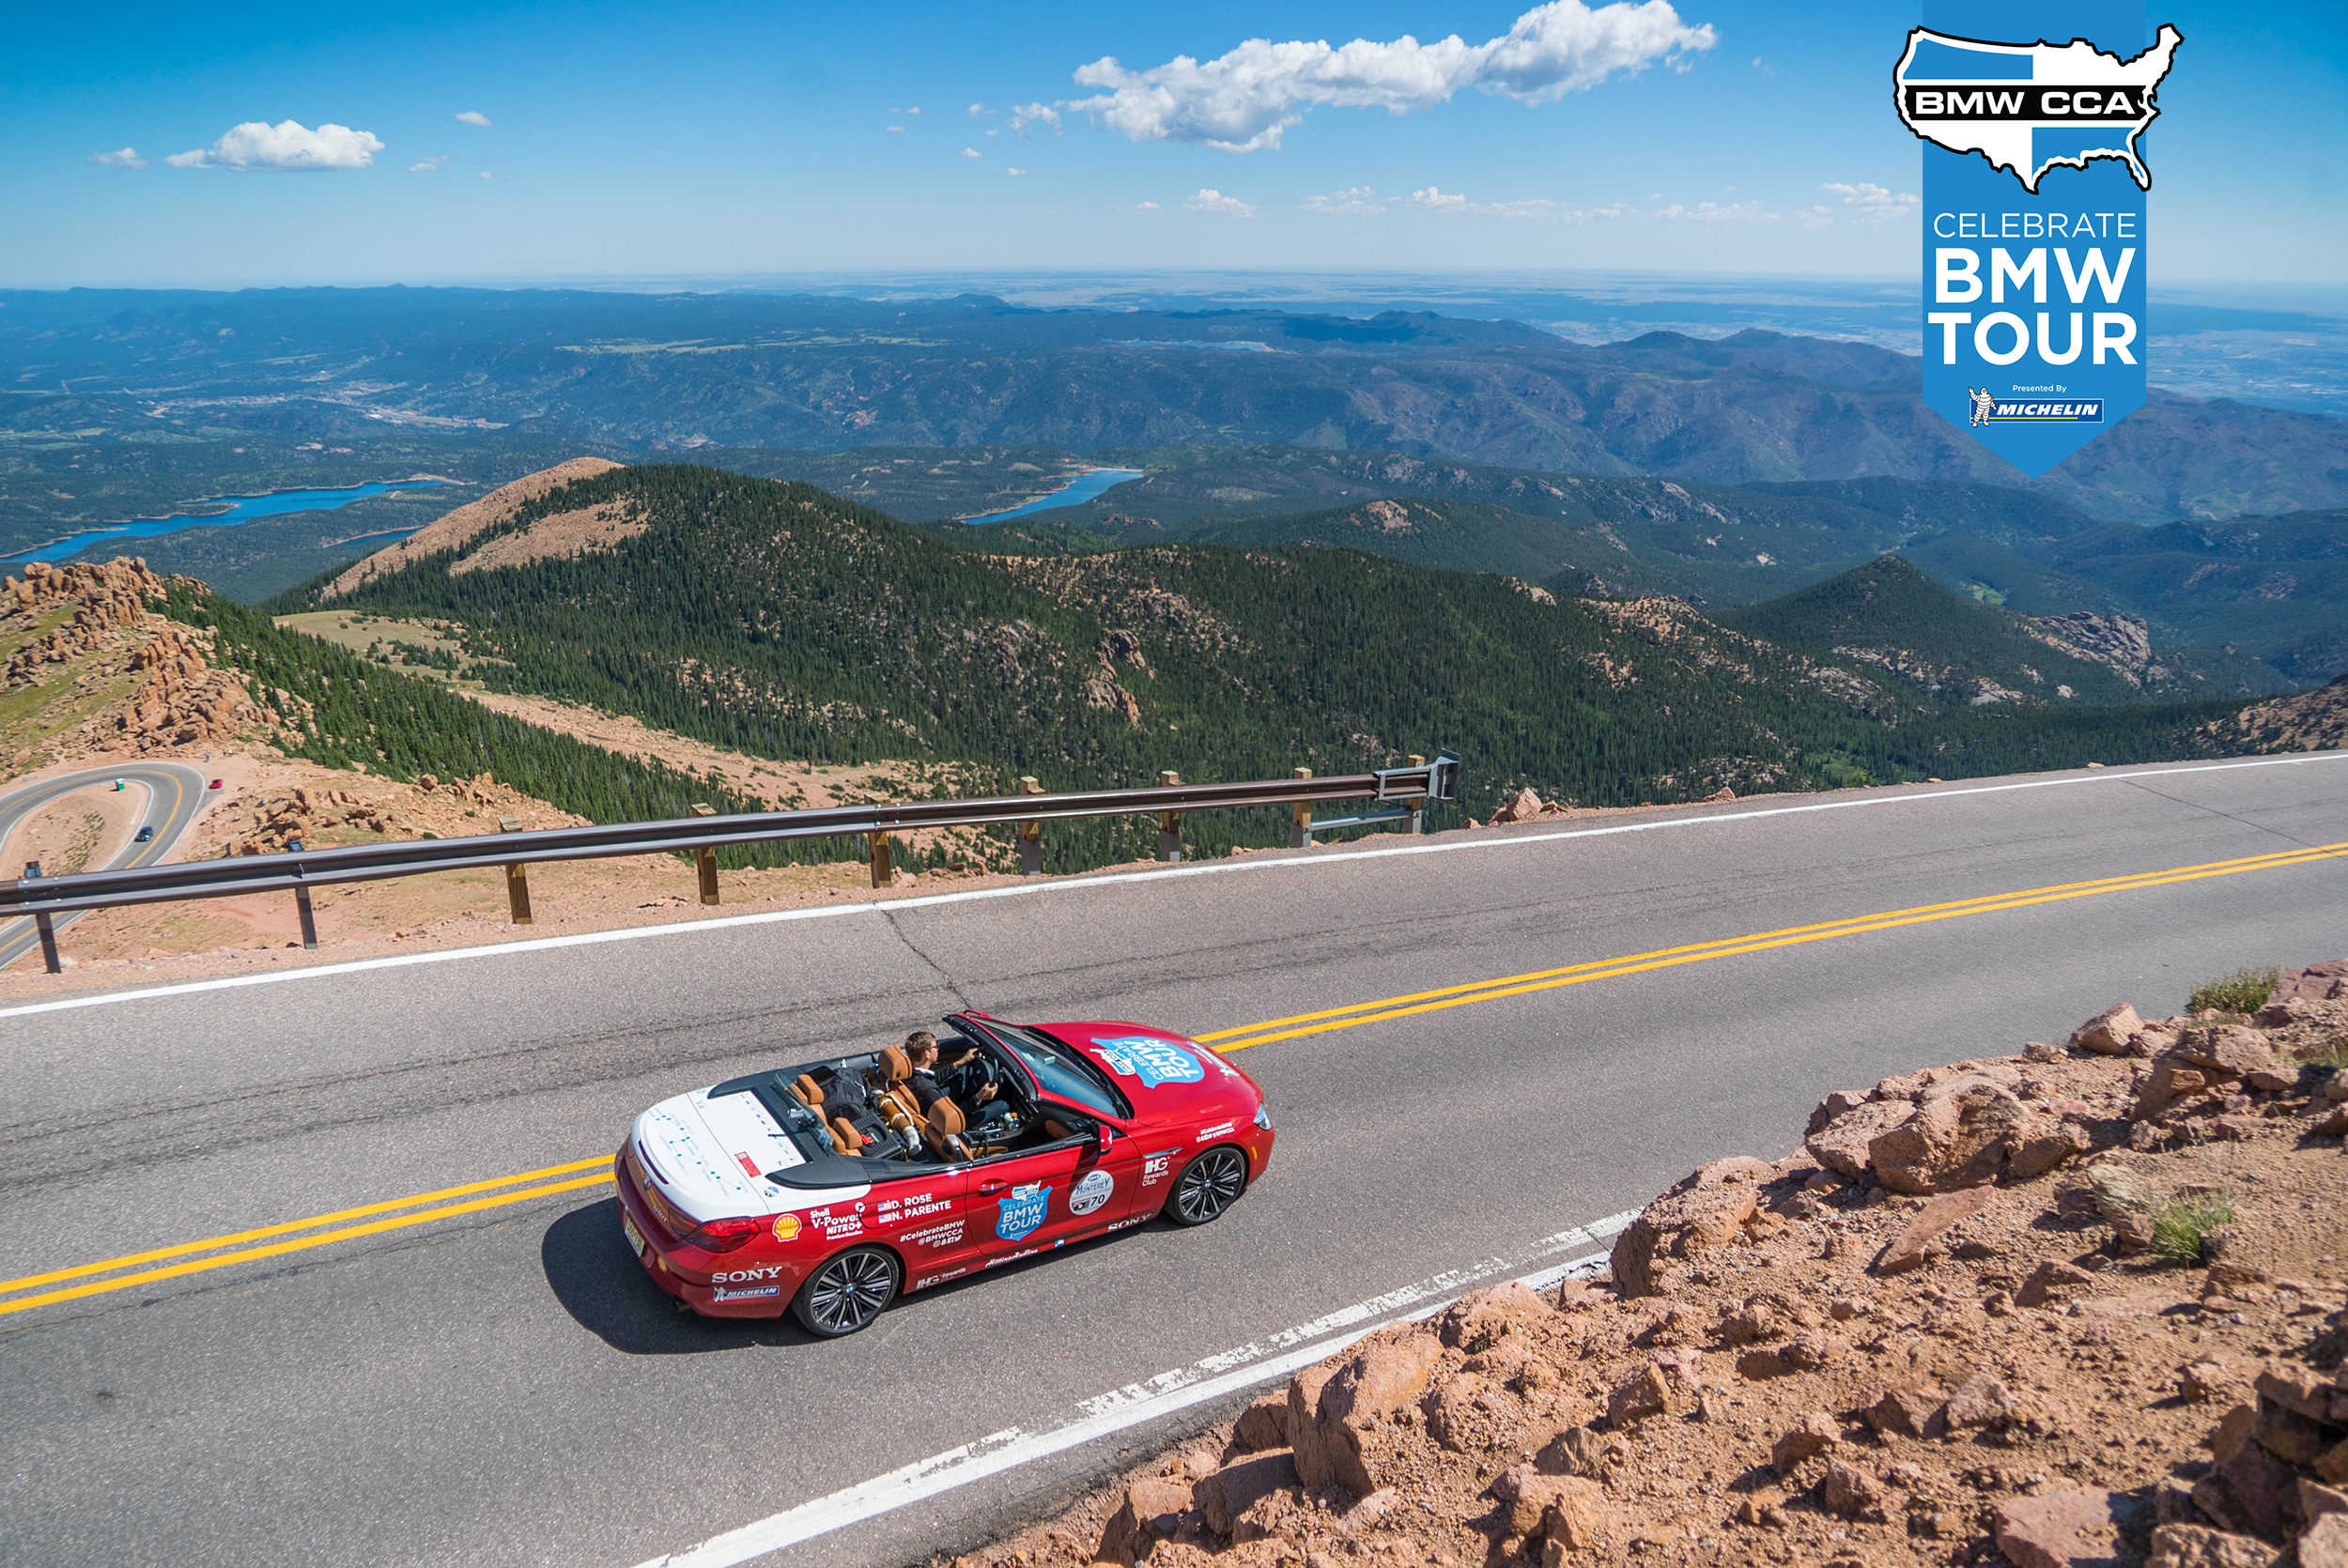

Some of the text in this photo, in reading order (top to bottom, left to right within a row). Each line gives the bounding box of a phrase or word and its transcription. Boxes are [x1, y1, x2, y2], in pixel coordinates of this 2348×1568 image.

[1112, 1041, 1165, 1081] CELEBRATE
[1124, 1040, 1183, 1079] BMW
[1143, 1038, 1200, 1079] TOUR
[1142, 1178, 1157, 1187] Club
[891, 1192, 933, 1210] D. ROSE
[1003, 1195, 1045, 1211] CELEBRATE
[1090, 1194, 1105, 1207] 70
[810, 1207, 830, 1220] Shell
[892, 1200, 951, 1222] N. PARENTE
[1003, 1202, 1044, 1223] BMW
[811, 1214, 863, 1229] V-Power
[1000, 1214, 1042, 1234] TOUR
[1107, 1213, 1152, 1232] SONY
[900, 1220, 965, 1243] #CelebrateBMW
[918, 1228, 964, 1246] @BMWCCA
[711, 1267, 782, 1284] SONY
[727, 1287, 777, 1298] MICHELIN
